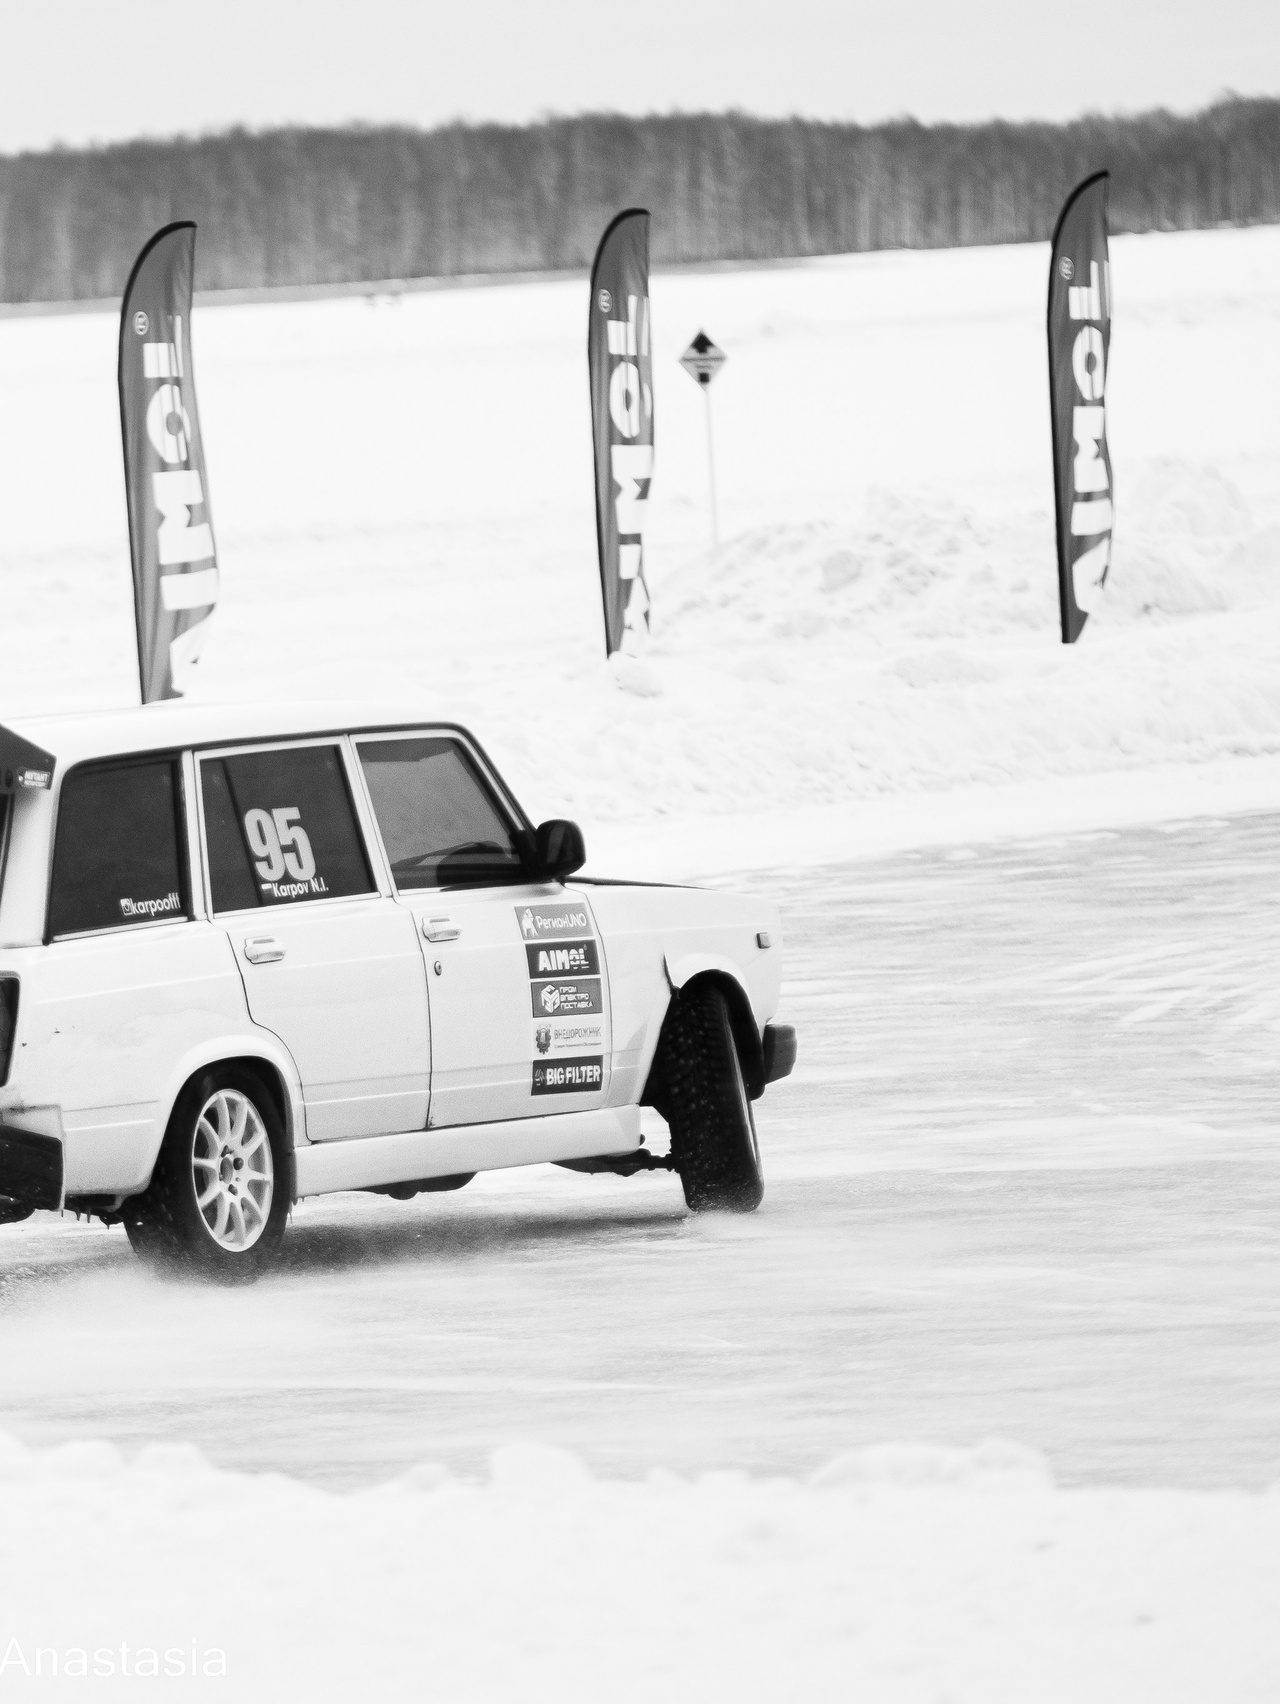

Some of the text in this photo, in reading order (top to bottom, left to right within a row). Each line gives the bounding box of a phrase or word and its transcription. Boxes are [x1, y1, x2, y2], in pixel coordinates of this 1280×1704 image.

[244, 806, 316, 881] 95
[272, 877, 329, 898] Karpov N.I.
[538, 948, 589, 971] AIMOL
[560, 1001, 593, 1009] ПОСТАВКА
[546, 1065, 601, 1085] BIG FILTER
